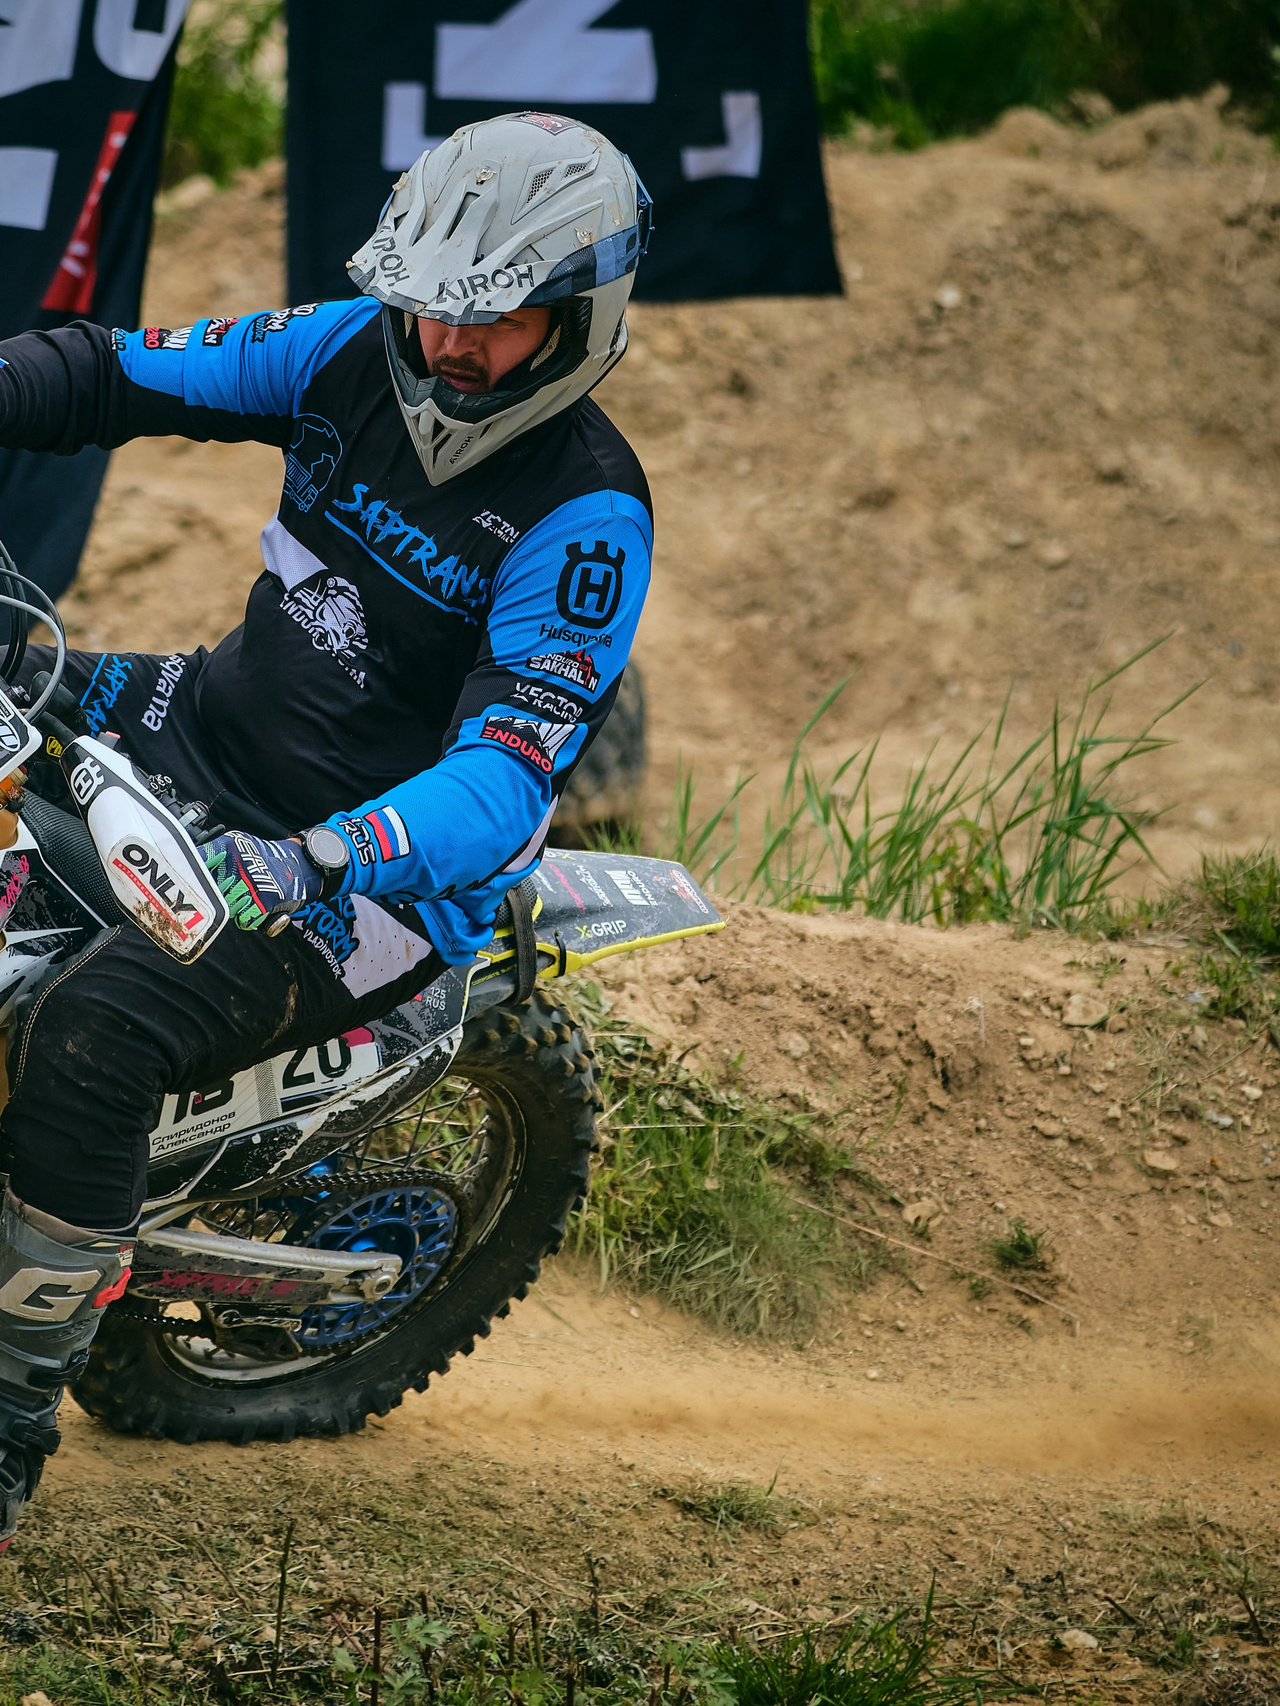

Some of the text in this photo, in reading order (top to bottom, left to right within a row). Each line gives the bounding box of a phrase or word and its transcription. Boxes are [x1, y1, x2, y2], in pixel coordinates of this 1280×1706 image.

[480, 726, 553, 773] ENDURO
[575, 919, 627, 939] X-GRIP
[426, 997, 446, 1011] RUS
[429, 986, 447, 999] 125
[152, 1111, 236, 1147] Спиридонов
[155, 1122, 231, 1153] Александр
